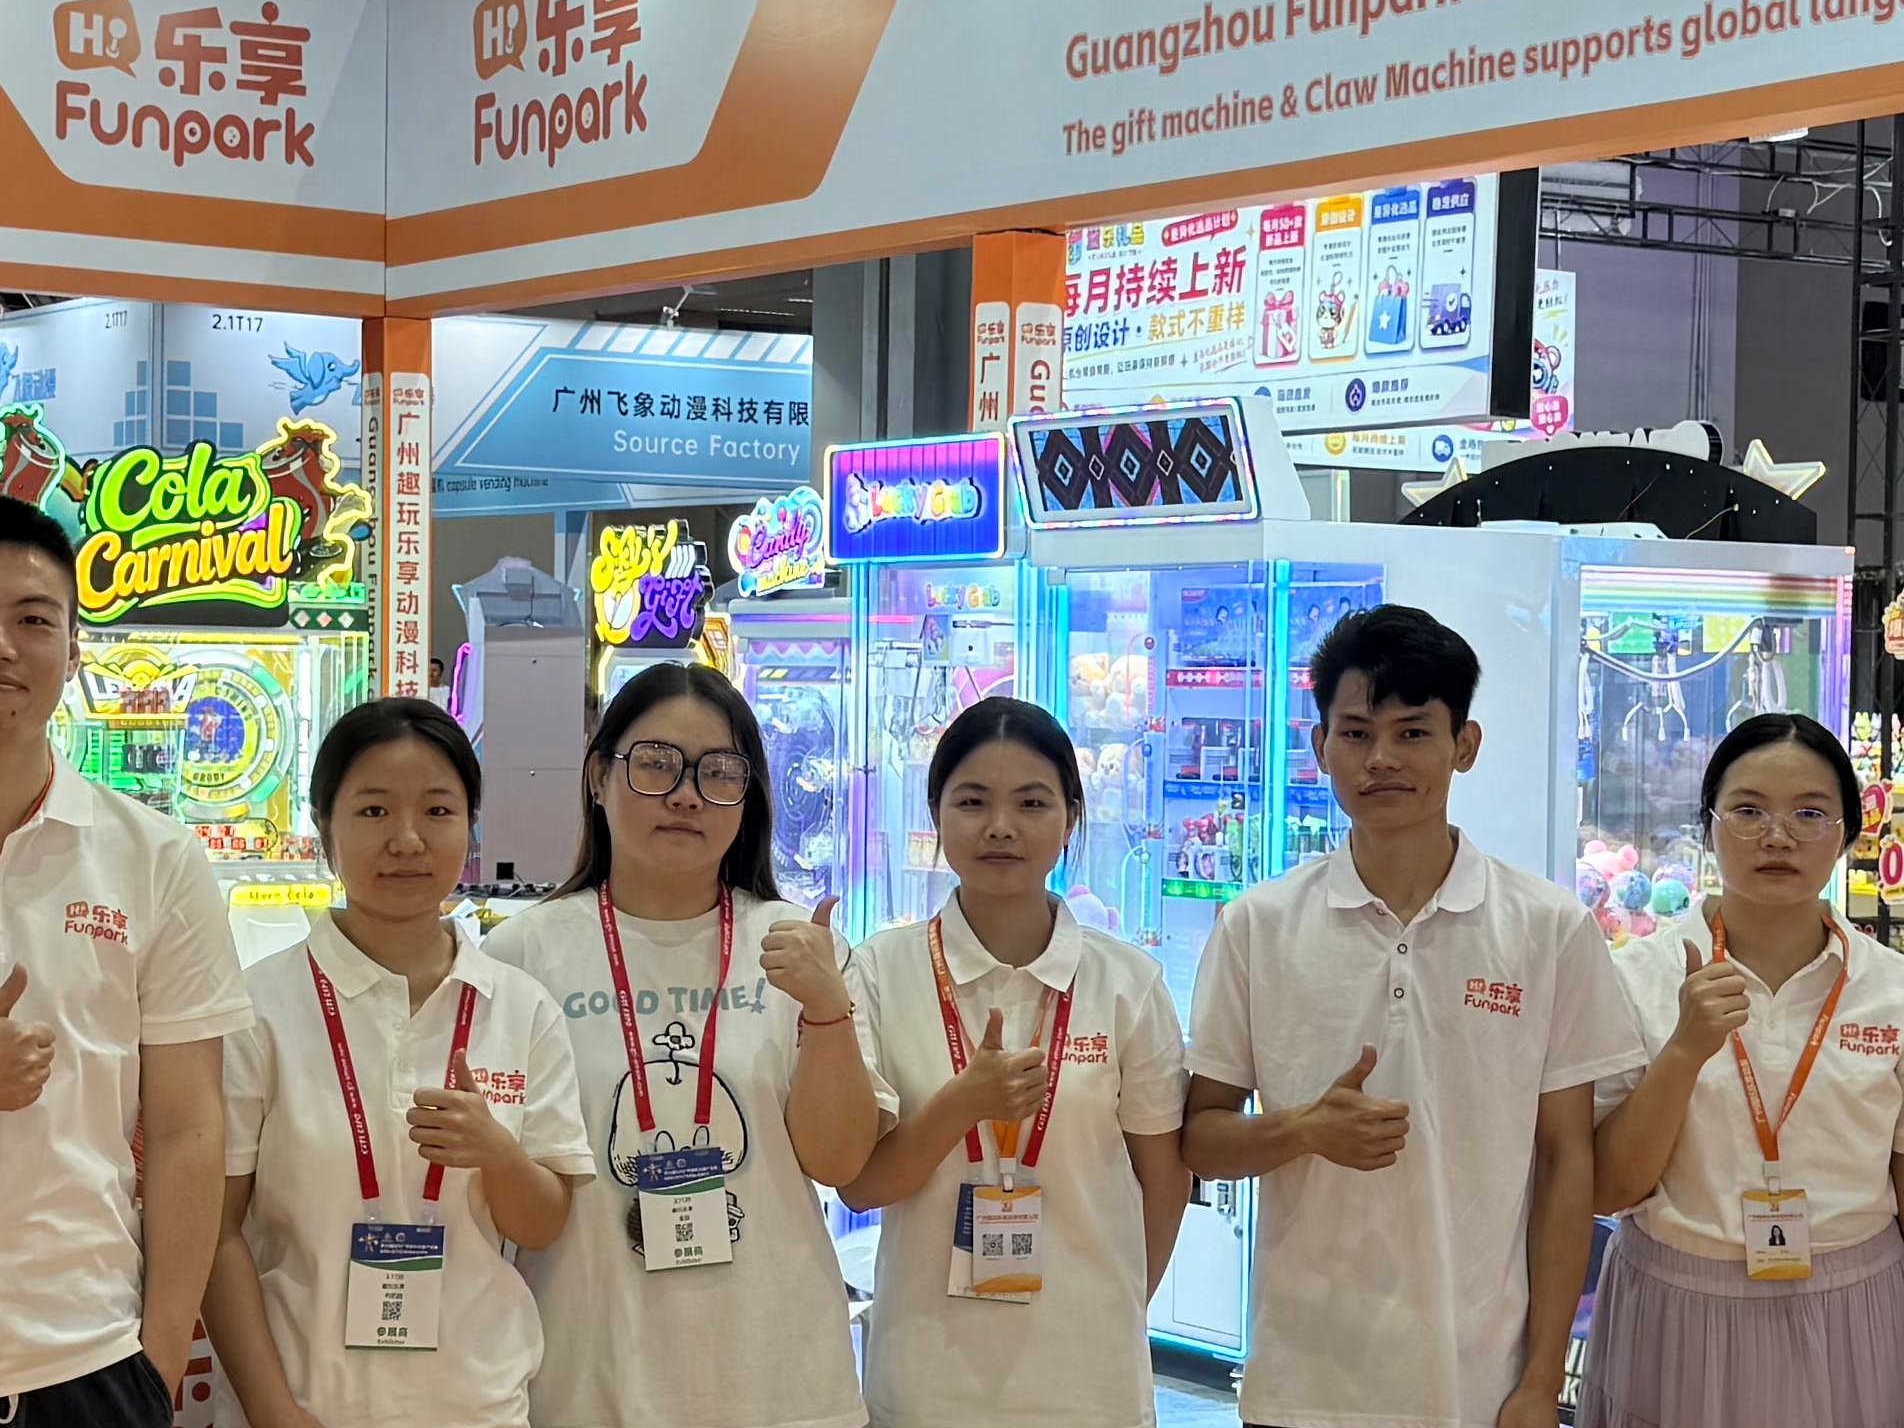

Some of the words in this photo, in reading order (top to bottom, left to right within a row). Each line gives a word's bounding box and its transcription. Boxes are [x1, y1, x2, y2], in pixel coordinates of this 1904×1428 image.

[154, 0, 312, 106] 乐享
[1065, 1, 1276, 82] Guangzhou
[473, 61, 647, 168] Funpark
[1062, 122, 1107, 158] The
[1110, 106, 1157, 156] gift
[1160, 86, 1274, 140] machine
[1279, 83, 1299, 119] &
[1303, 72, 1379, 114] Claw
[1384, 44, 1516, 101] Machine
[1521, 13, 1674, 78] supports
[54, 80, 315, 168] Funpark
[212, 313, 264, 334] 2.1T17
[552, 386, 810, 426] 广州飞象动漫科技有限
[612, 429, 698, 456] Source
[709, 434, 801, 466] Factory
[102, 442, 253, 533] Cola
[367, 416, 380, 566] Guanghou
[75, 502, 294, 613] Carnival
[64, 920, 129, 945] Funpark
[1464, 993, 1521, 1019] Funpark
[1063, 1051, 1109, 1066] unpark
[1839, 1038, 1900, 1057] Funpark
[483, 1087, 526, 1105] npark
